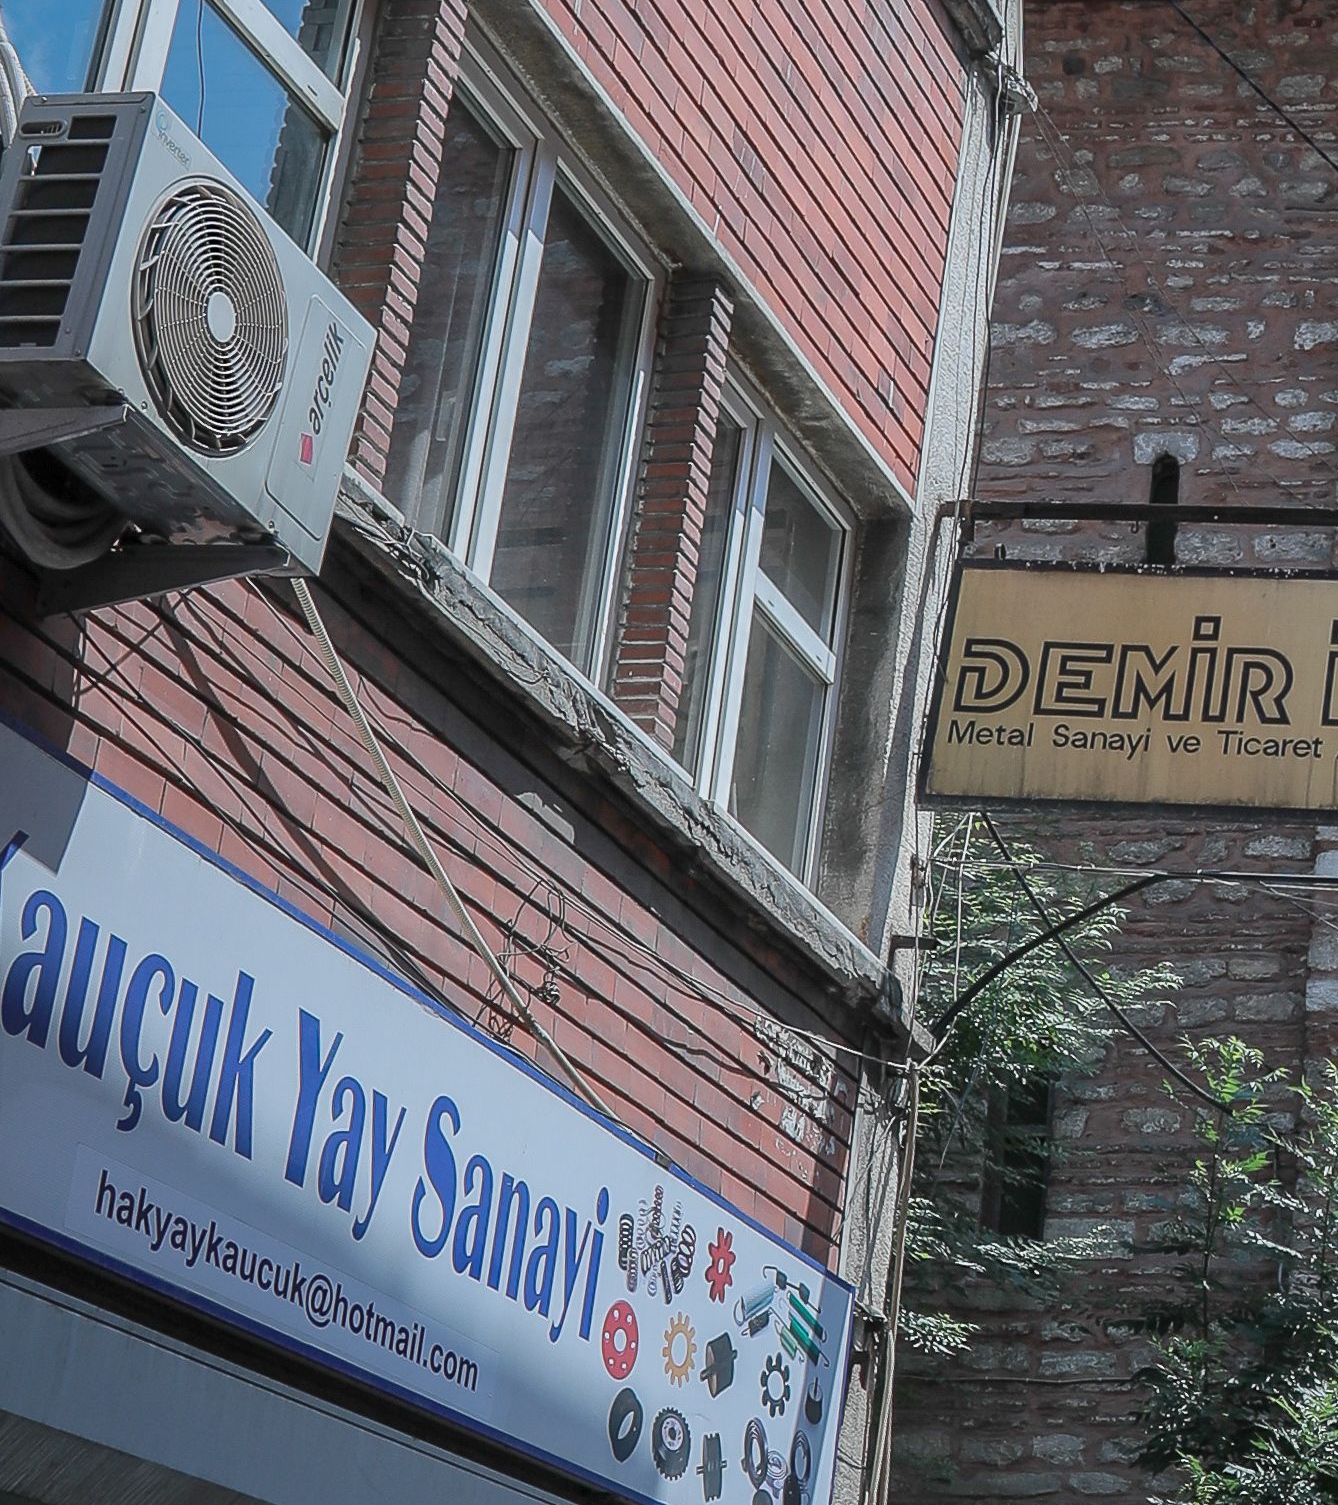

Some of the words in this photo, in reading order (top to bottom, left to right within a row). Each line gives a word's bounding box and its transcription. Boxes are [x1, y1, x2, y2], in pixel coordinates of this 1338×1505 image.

[309, 322, 344, 435] arçelik
[953, 616, 1294, 725] DEMİR
[946, 719, 1034, 748] Metal
[1052, 722, 1151, 761] Sanayi
[1167, 733, 1201, 754] ve
[1217, 729, 1324, 759] Ticaret
[0, 829, 273, 1160] auçuk
[284, 1007, 407, 1241] Yay
[411, 1095, 611, 1343] Sanayi
[95, 1169, 479, 1392] hakyaykaucuk@hotmail.com
